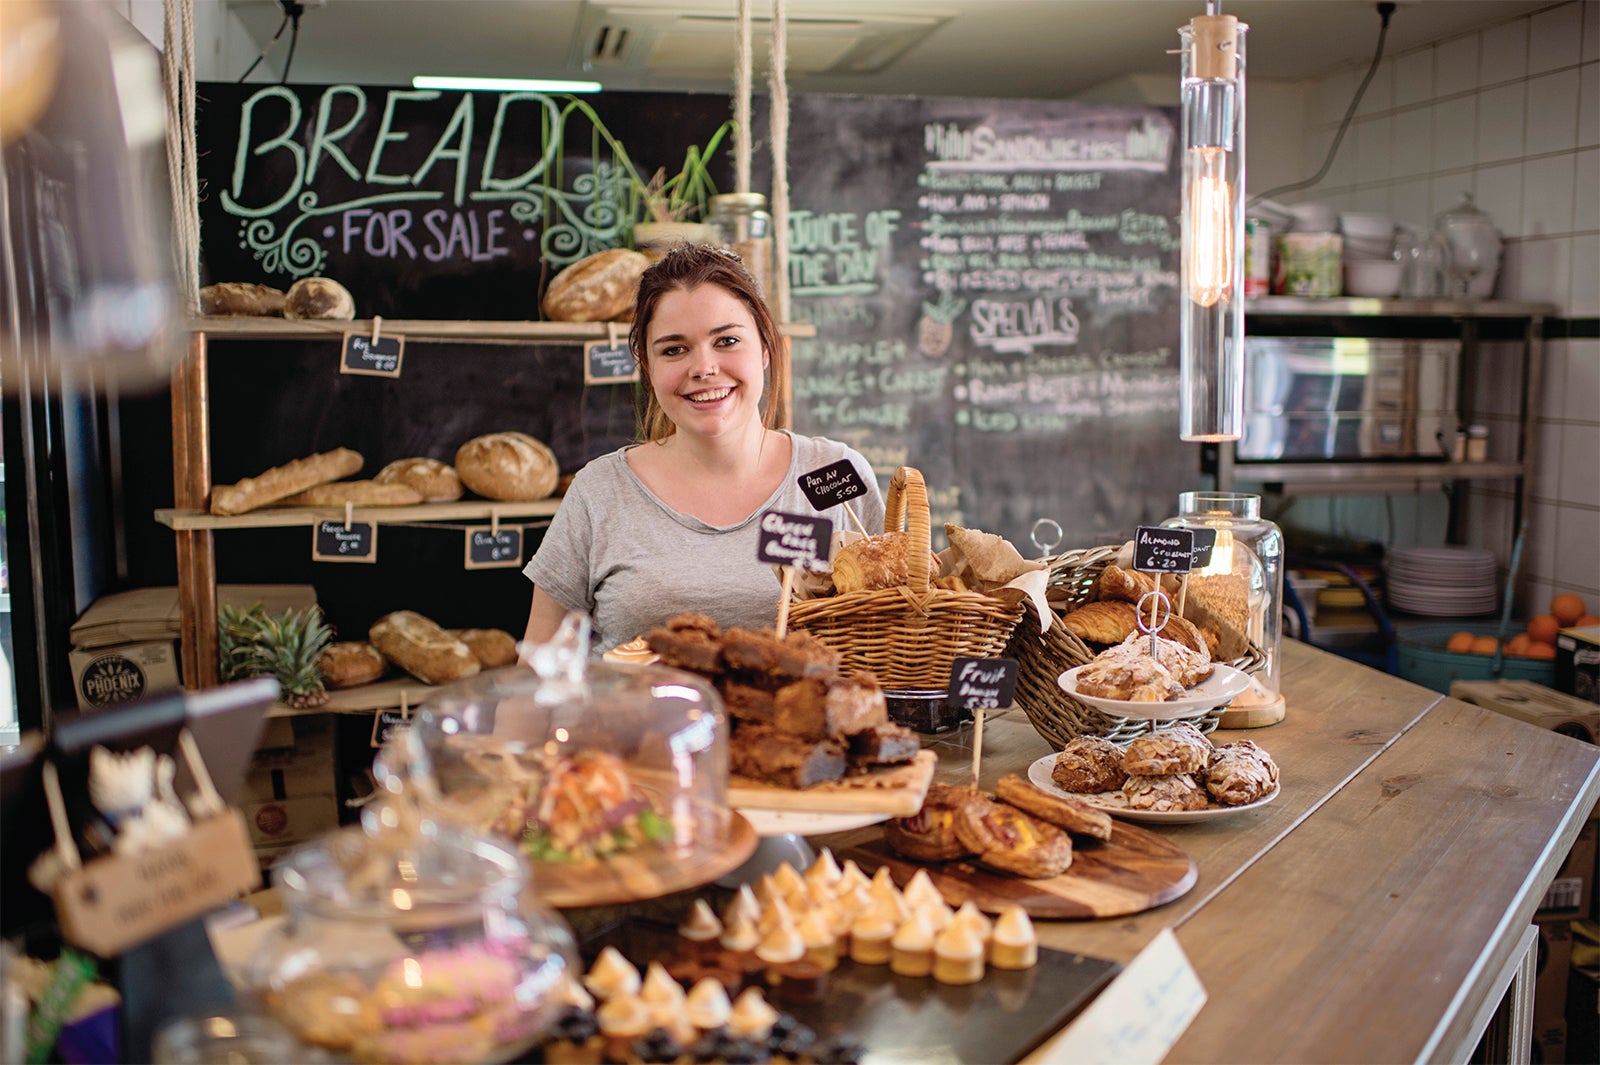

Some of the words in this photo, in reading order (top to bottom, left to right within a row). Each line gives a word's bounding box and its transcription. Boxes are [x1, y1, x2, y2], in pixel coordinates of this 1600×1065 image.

[221, 85, 559, 217] BREAD
[342, 208, 418, 258] FOR
[423, 209, 509, 262] SALE
[865, 210, 901, 246] OF
[788, 253, 828, 286] THE
[835, 248, 879, 284] DAY
[971, 298, 1080, 337] SPECIALS
[815, 473, 852, 495] CHOCOLAT
[1140, 531, 1181, 546] ALMOND
[86, 671, 141, 696] PHOENIX
[959, 661, 1006, 684] Fruit
